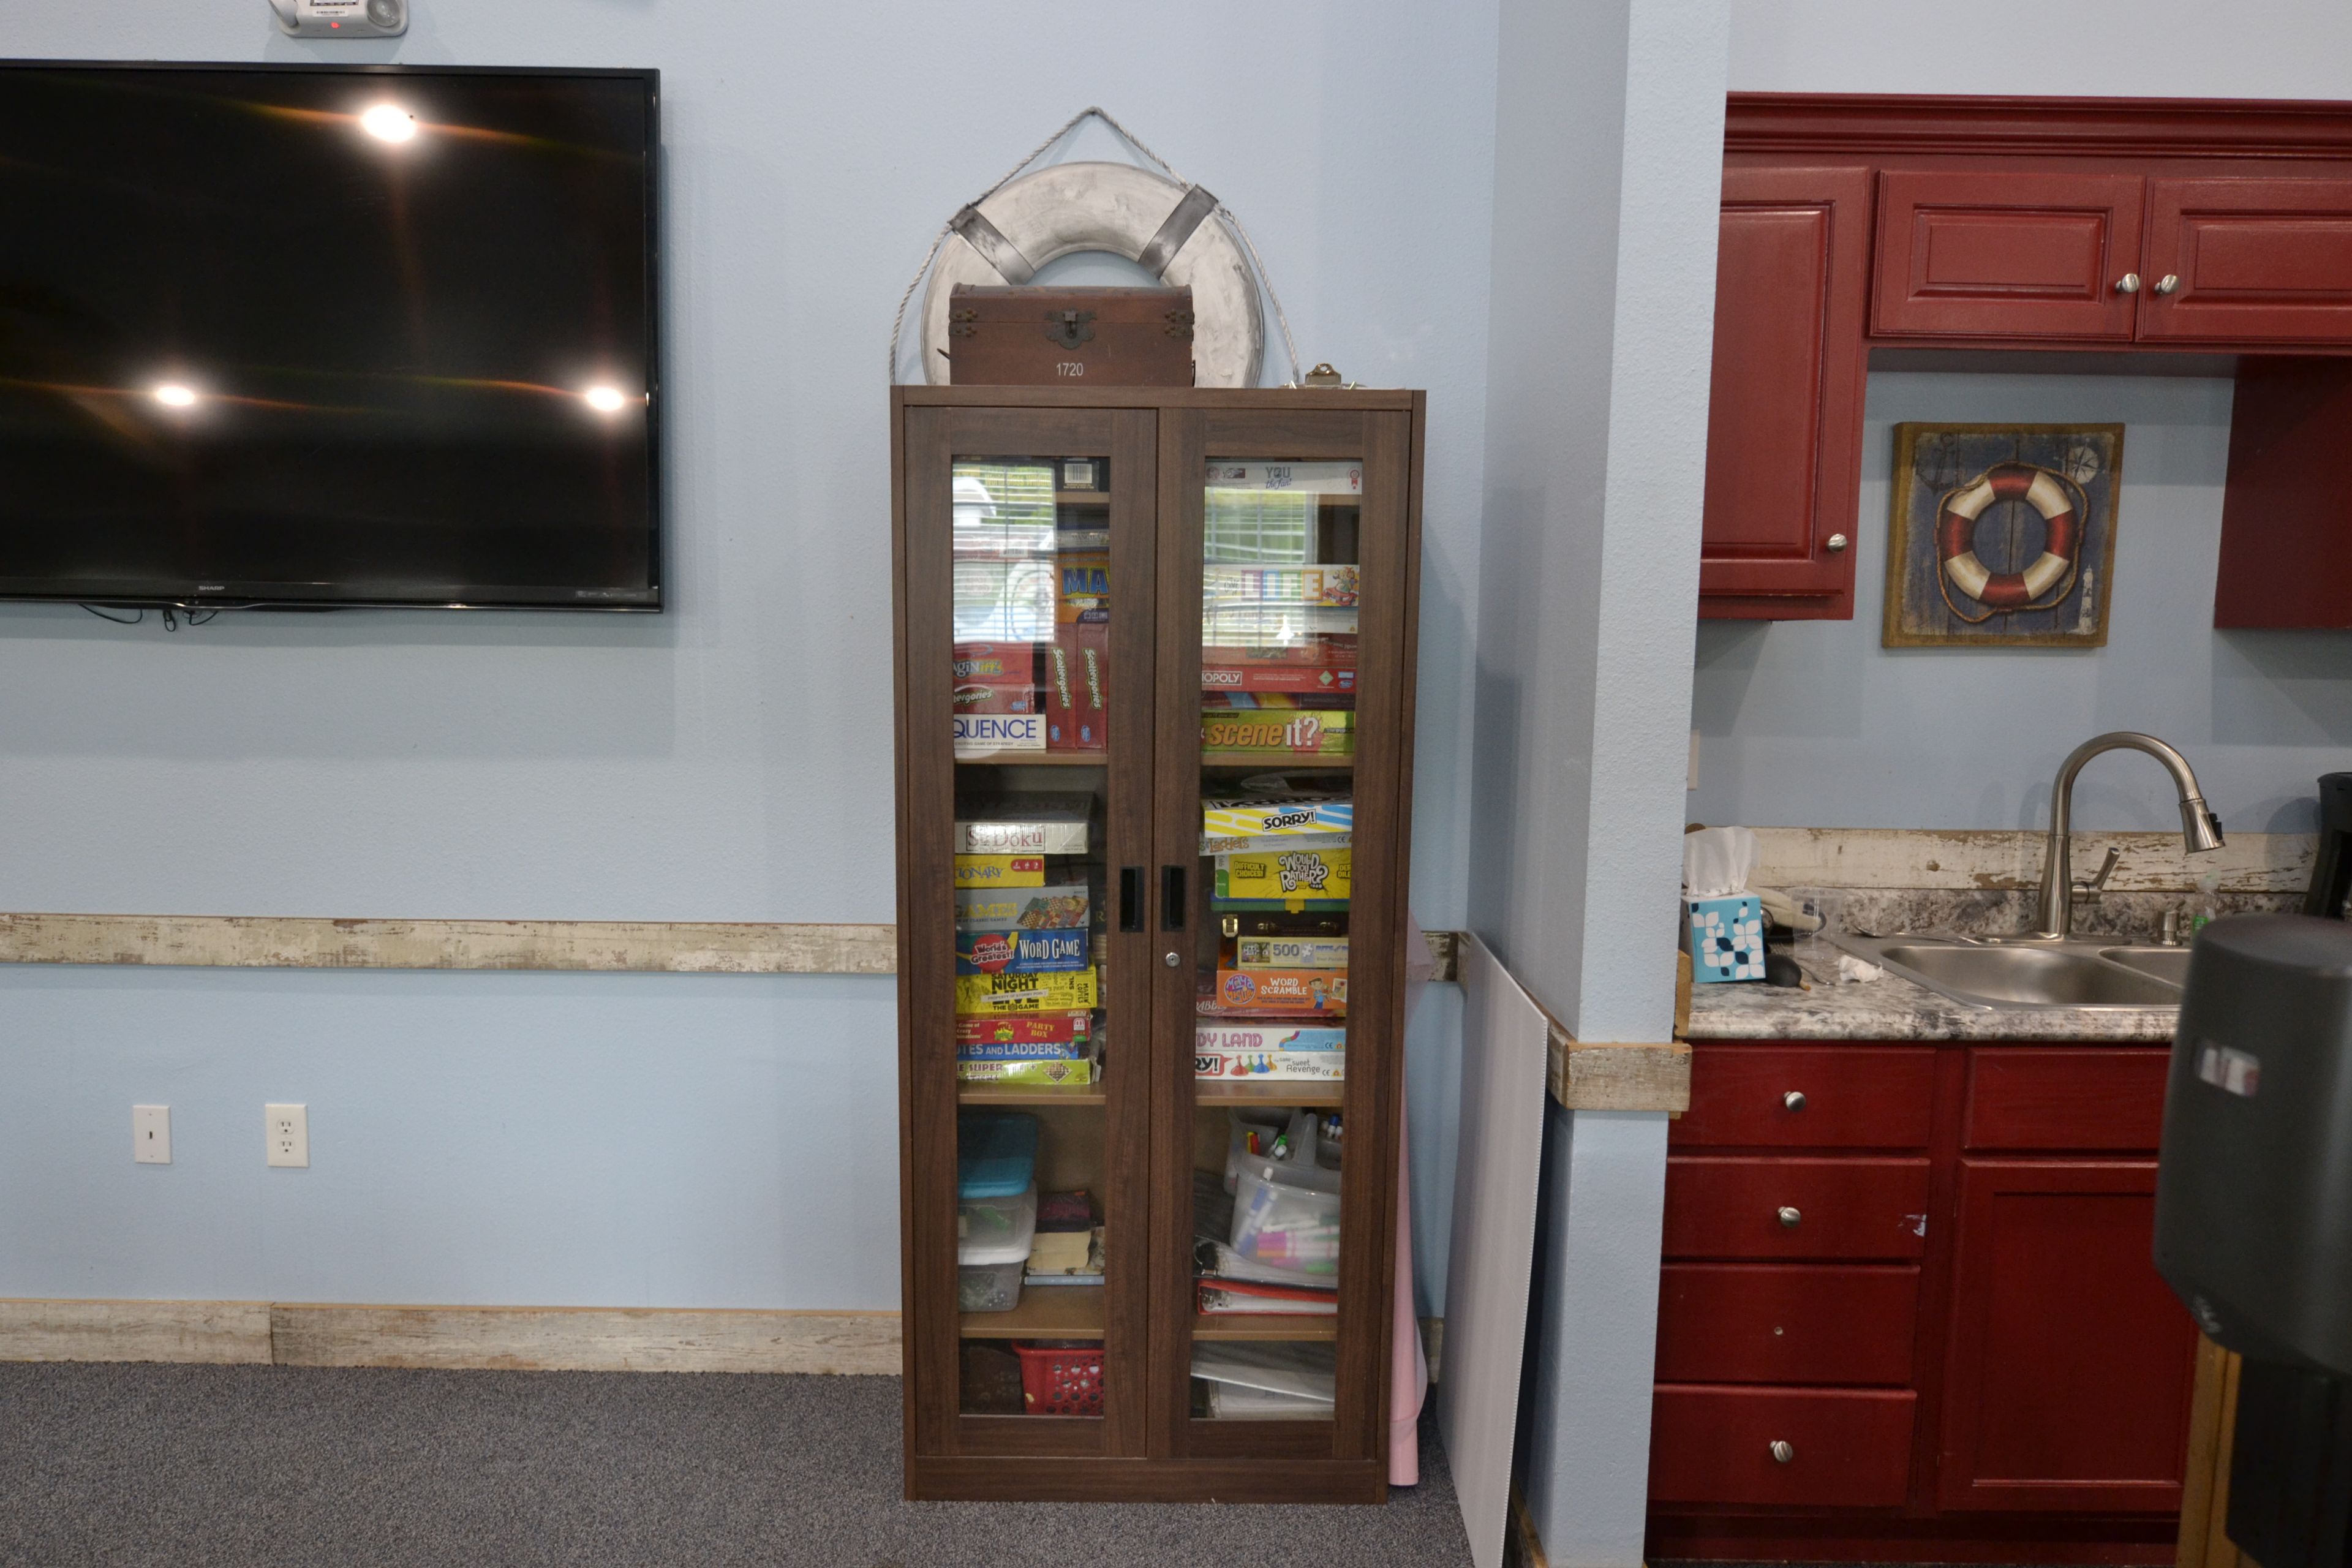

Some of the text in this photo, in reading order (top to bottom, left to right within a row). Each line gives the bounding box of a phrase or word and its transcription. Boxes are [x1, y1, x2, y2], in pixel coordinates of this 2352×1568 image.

[1056, 362, 1084, 377] 1720
[1265, 467, 1291, 478] YOU
[1242, 571, 1322, 600] LIFE
[1052, 648, 1071, 708] Scattergories
[1084, 648, 1102, 709] Scattergories
[1209, 723, 1284, 746] scene
[1263, 810, 1315, 830] SORRY!
[1234, 861, 1265, 870] DIFFICULT
[1279, 851, 1319, 870] WOULD
[1295, 864, 1310, 872] YOU
[975, 941, 1008, 954] World's
[1019, 938, 1080, 960] WORD GAME
[1273, 944, 1299, 957] 500
[971, 949, 1015, 965] Greatest!
[992, 979, 1039, 990] NIGHT
[1270, 978, 1298, 987] WORD
[1261, 986, 1307, 995] SCRAMBLE
[1026, 1021, 1055, 1032] PARTY
[1030, 1030, 1049, 1038] BOX
[1221, 1032, 1263, 1047] LAND
[986, 1046, 1003, 1055] AND
[1005, 1043, 1061, 1055] LADDERS
[970, 1063, 1003, 1071] SUPER
[1286, 1065, 1321, 1075] Revenge
